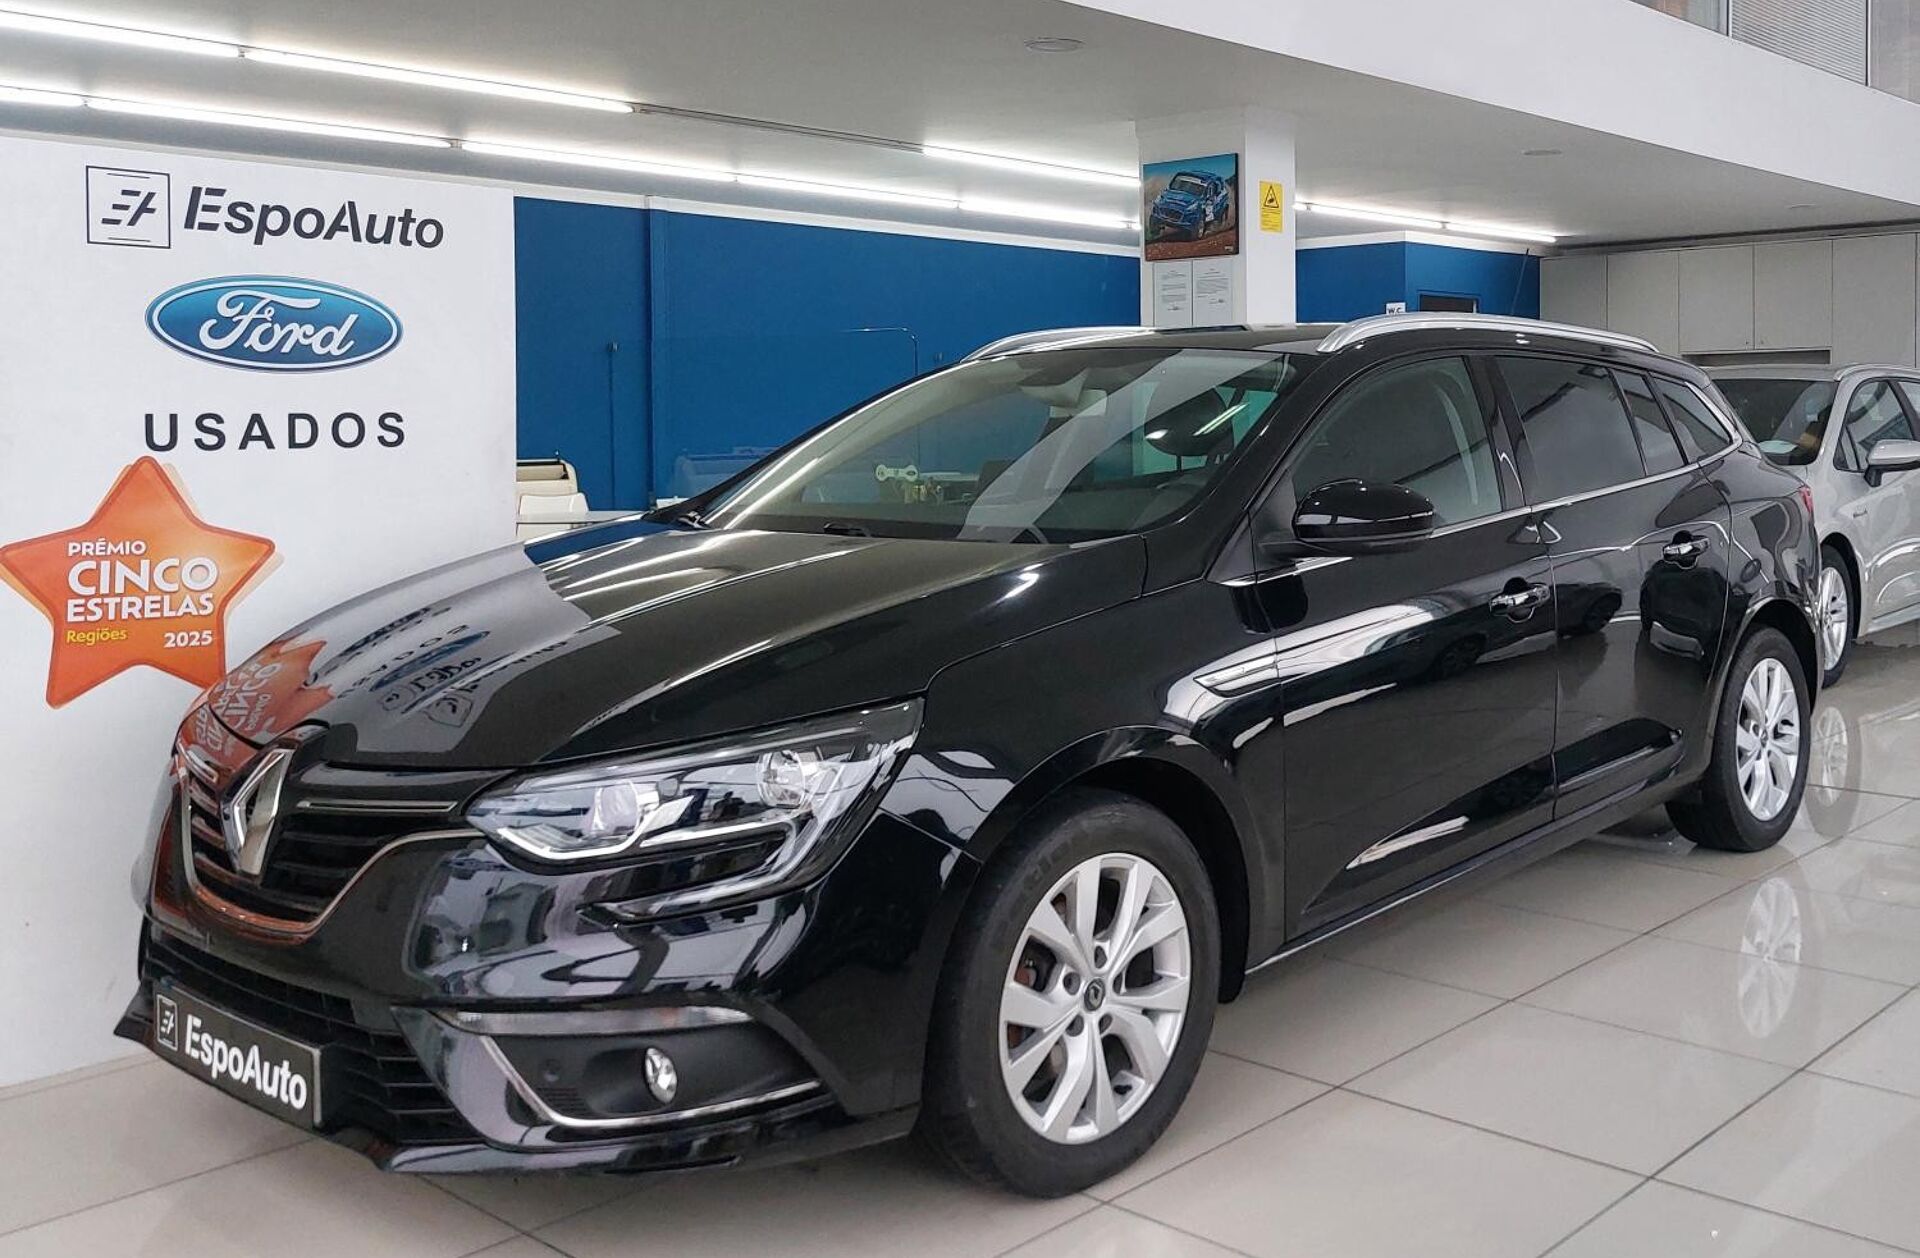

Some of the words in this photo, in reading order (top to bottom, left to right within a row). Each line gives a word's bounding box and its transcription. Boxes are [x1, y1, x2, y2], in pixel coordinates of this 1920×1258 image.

[184, 185, 444, 248] EspoAuto
[199, 289, 355, 357] Ford
[144, 411, 406, 452] USADOS
[67, 538, 147, 557] PRÉMIO
[68, 557, 219, 595] CINCO
[67, 593, 215, 622] ESTRELAS
[66, 627, 128, 647] Regiões
[163, 630, 213, 648] 2025
[184, 1014, 308, 1111] EspoAuto
